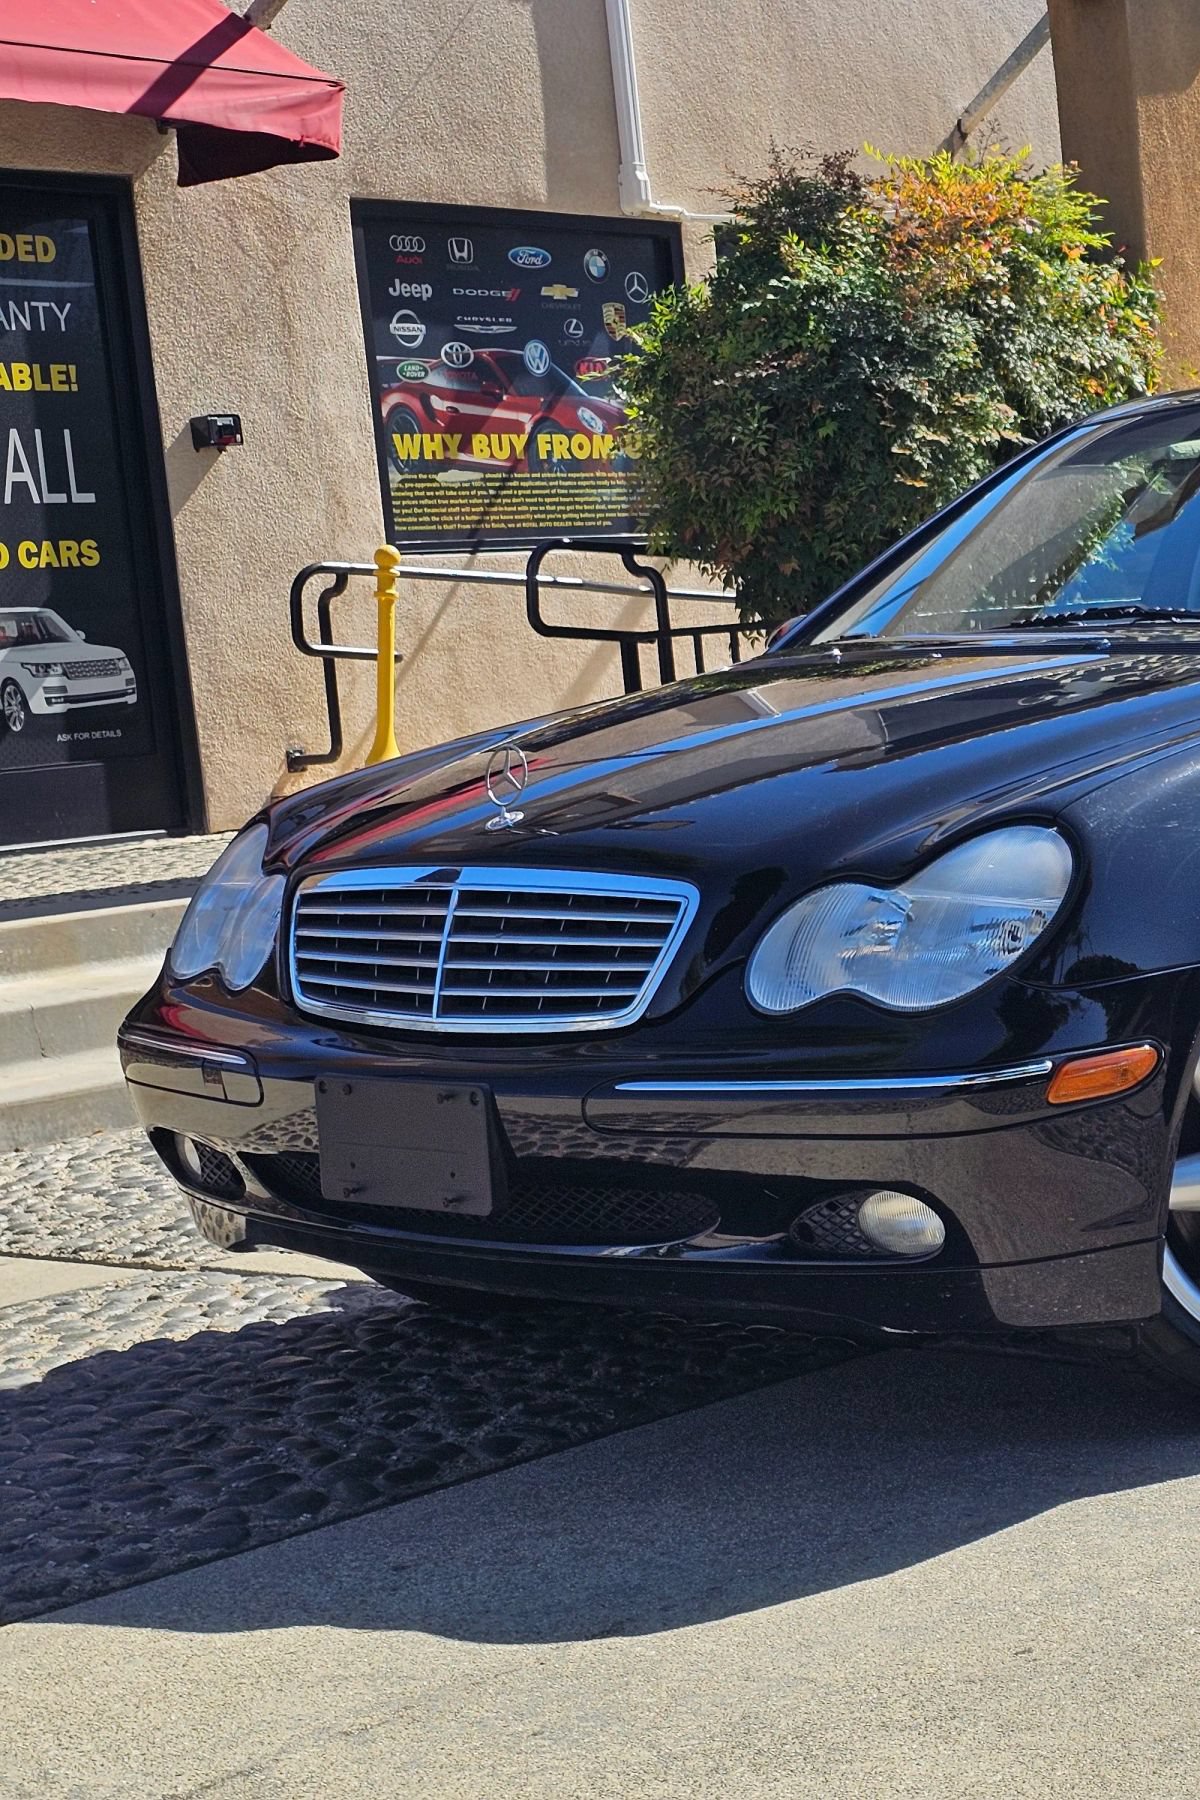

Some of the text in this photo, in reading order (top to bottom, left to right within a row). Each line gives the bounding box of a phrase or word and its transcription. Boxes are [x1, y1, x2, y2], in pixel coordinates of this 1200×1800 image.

[517, 249, 543, 265] Ford
[388, 278, 433, 301] Jeep
[453, 288, 512, 297] DODGE
[393, 325, 423, 333] NISSAN
[392, 433, 462, 461] WHY
[472, 433, 530, 461] BUY
[4, 428, 97, 505] ALL
[17, 540, 101, 569] CARS
[56, 729, 122, 742] ASK FOR DETAILS
